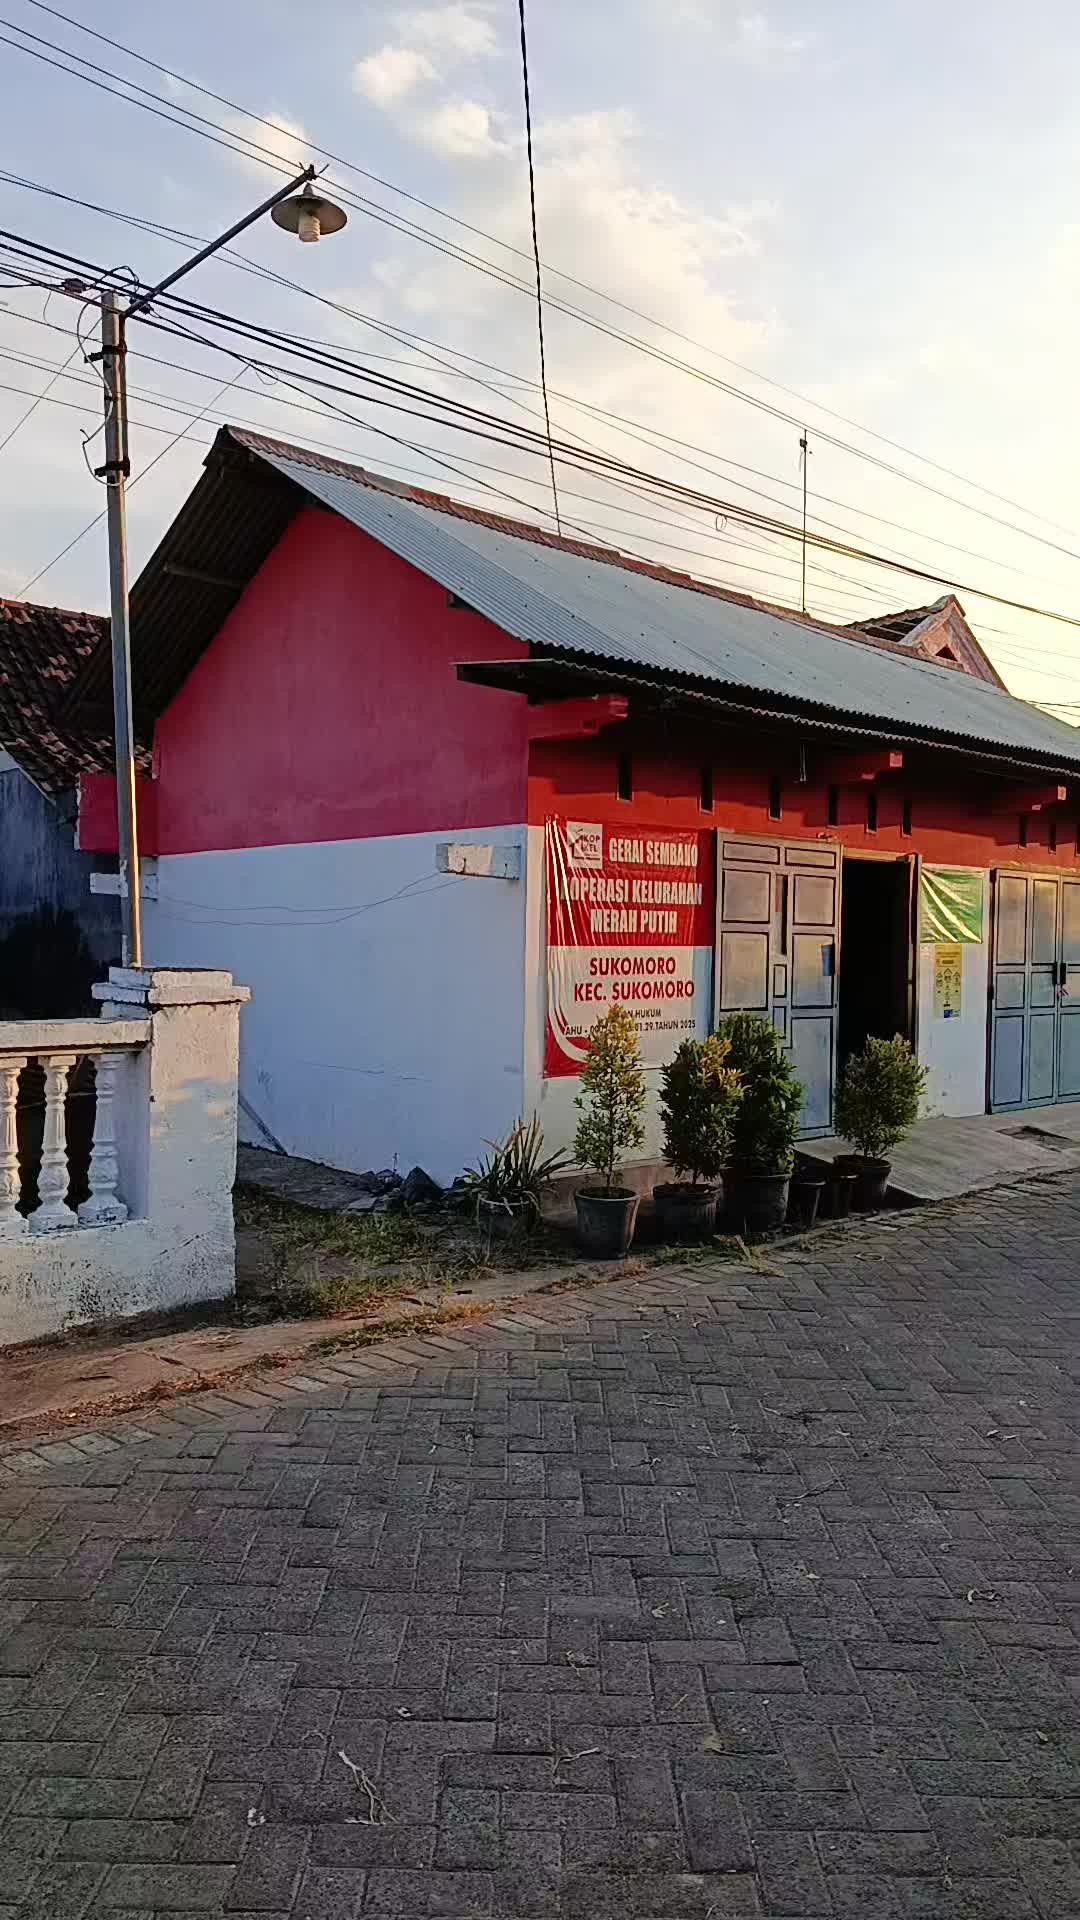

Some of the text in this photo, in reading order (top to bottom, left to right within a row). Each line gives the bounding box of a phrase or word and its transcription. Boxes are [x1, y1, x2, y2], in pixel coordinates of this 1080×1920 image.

[583, 834, 600, 843] KOP
[609, 838, 698, 867] GERAI SEMBAKO
[632, 880, 702, 904] KELURAHAN
[590, 909, 677, 933] MERAH PUTIH
[590, 957, 676, 976] SUKOMORO
[575, 980, 695, 1001] KEC. SUKOMORO
[635, 1008, 661, 1018] HUKUM
[565, 1026, 582, 1035] AHU
[680, 1019, 696, 1029] 2025
